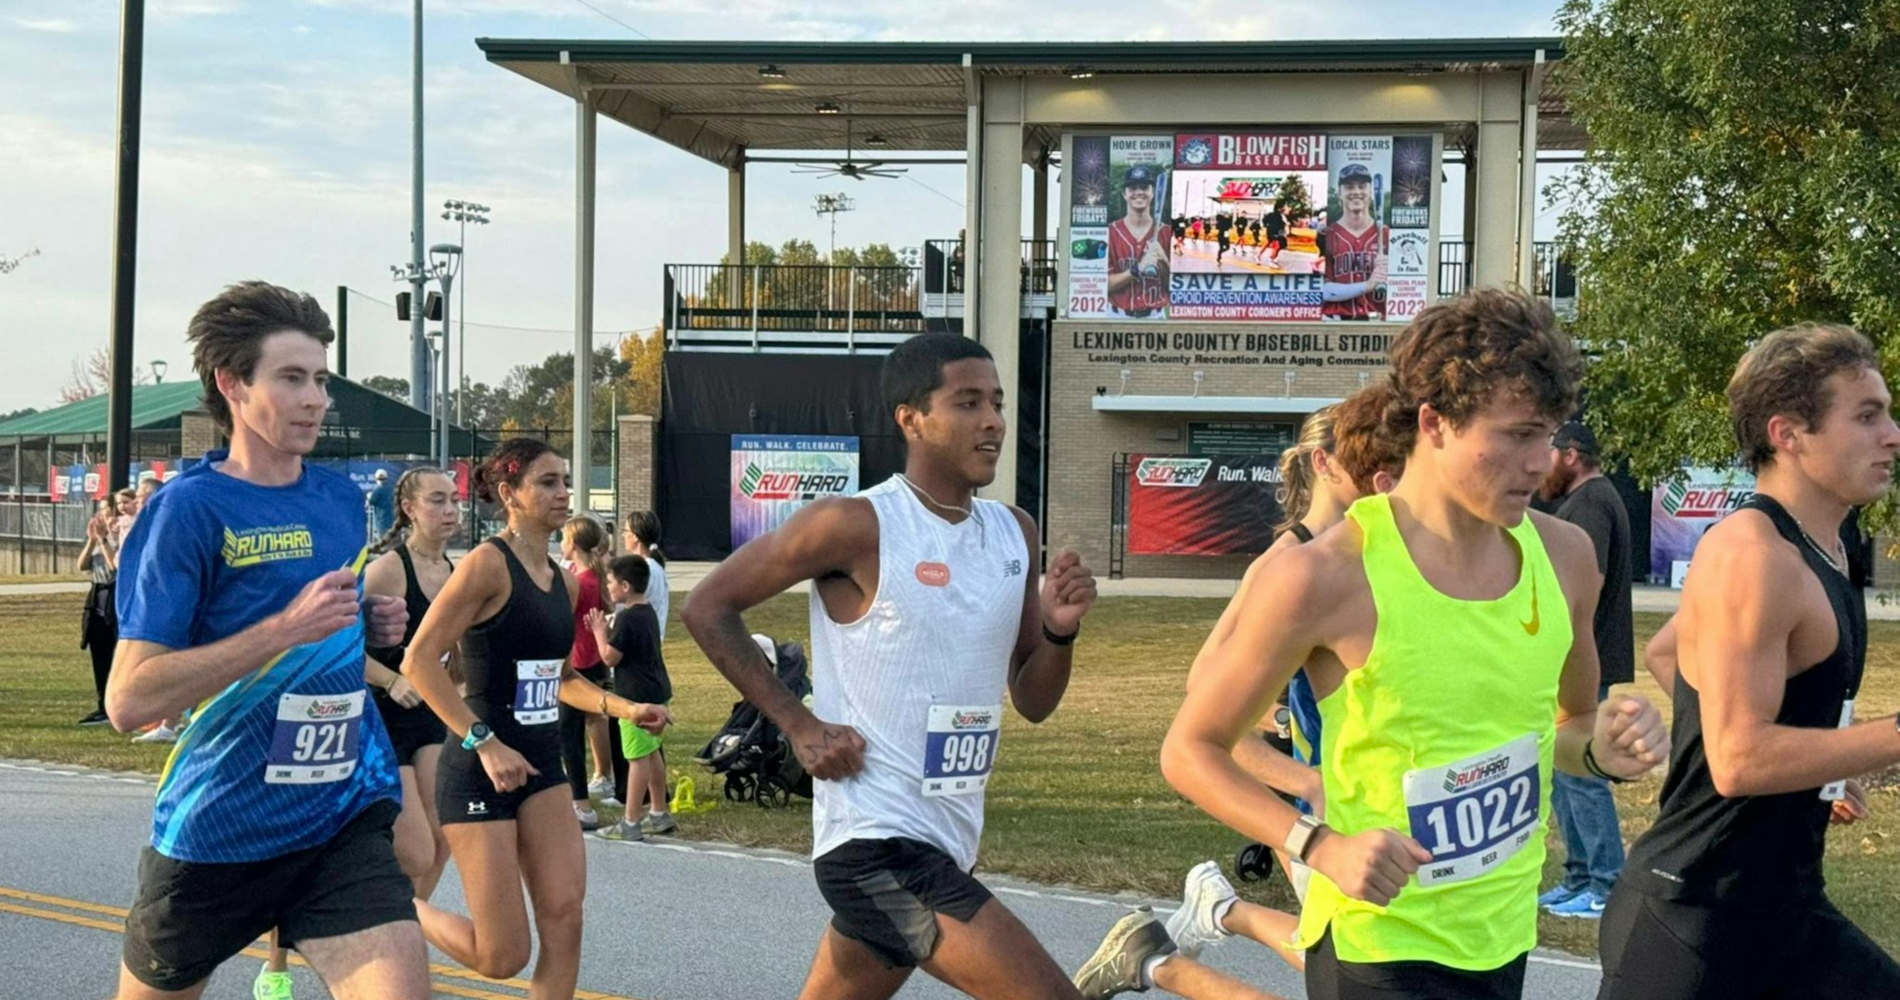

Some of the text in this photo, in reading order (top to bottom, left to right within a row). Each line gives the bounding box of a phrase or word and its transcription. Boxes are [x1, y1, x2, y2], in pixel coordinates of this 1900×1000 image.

[1113, 140, 1172, 150] HOME GROWN
[1218, 135, 1327, 168] BLOWFISH
[1330, 140, 1391, 150] LOCAL STARS
[1235, 155, 1307, 166] BASEBALL
[1391, 208, 1428, 216] FIREWORKS
[1391, 216, 1428, 225] FRIDAYS!
[1390, 232, 1429, 245] Baseball
[1171, 274, 1321, 290] SAVE A LIFE
[1070, 297, 1106, 312] 2012
[1170, 292, 1321, 305] OPIOID PREVENTION AWARENESS
[1170, 306, 1321, 318] LEXINGTON COUNTY CORONER'S OFFICE
[1387, 300, 1426, 316] 2023
[1073, 332, 1393, 352] LEXINGTON COUNTY BASEBALL STADI
[1088, 353, 1146, 364] Lexington
[1150, 354, 1191, 365] County
[1195, 354, 1259, 364] Recreation
[1263, 356, 1286, 364] And
[1290, 356, 1323, 366] Aging
[742, 440, 849, 451] RUN. WALK. CELEBRATE.
[1148, 465, 1205, 480] RUNHARD
[1217, 465, 1247, 481] Run.
[757, 474, 849, 492] RUNHARD
[237, 531, 313, 556] RUNHARD
[293, 722, 348, 761] 921
[941, 734, 990, 773] 998
[1456, 756, 1510, 786] RUNHARD
[1427, 776, 1531, 856] 1022
[1432, 866, 1455, 879] DRINK
[1482, 852, 1498, 866] BEER
